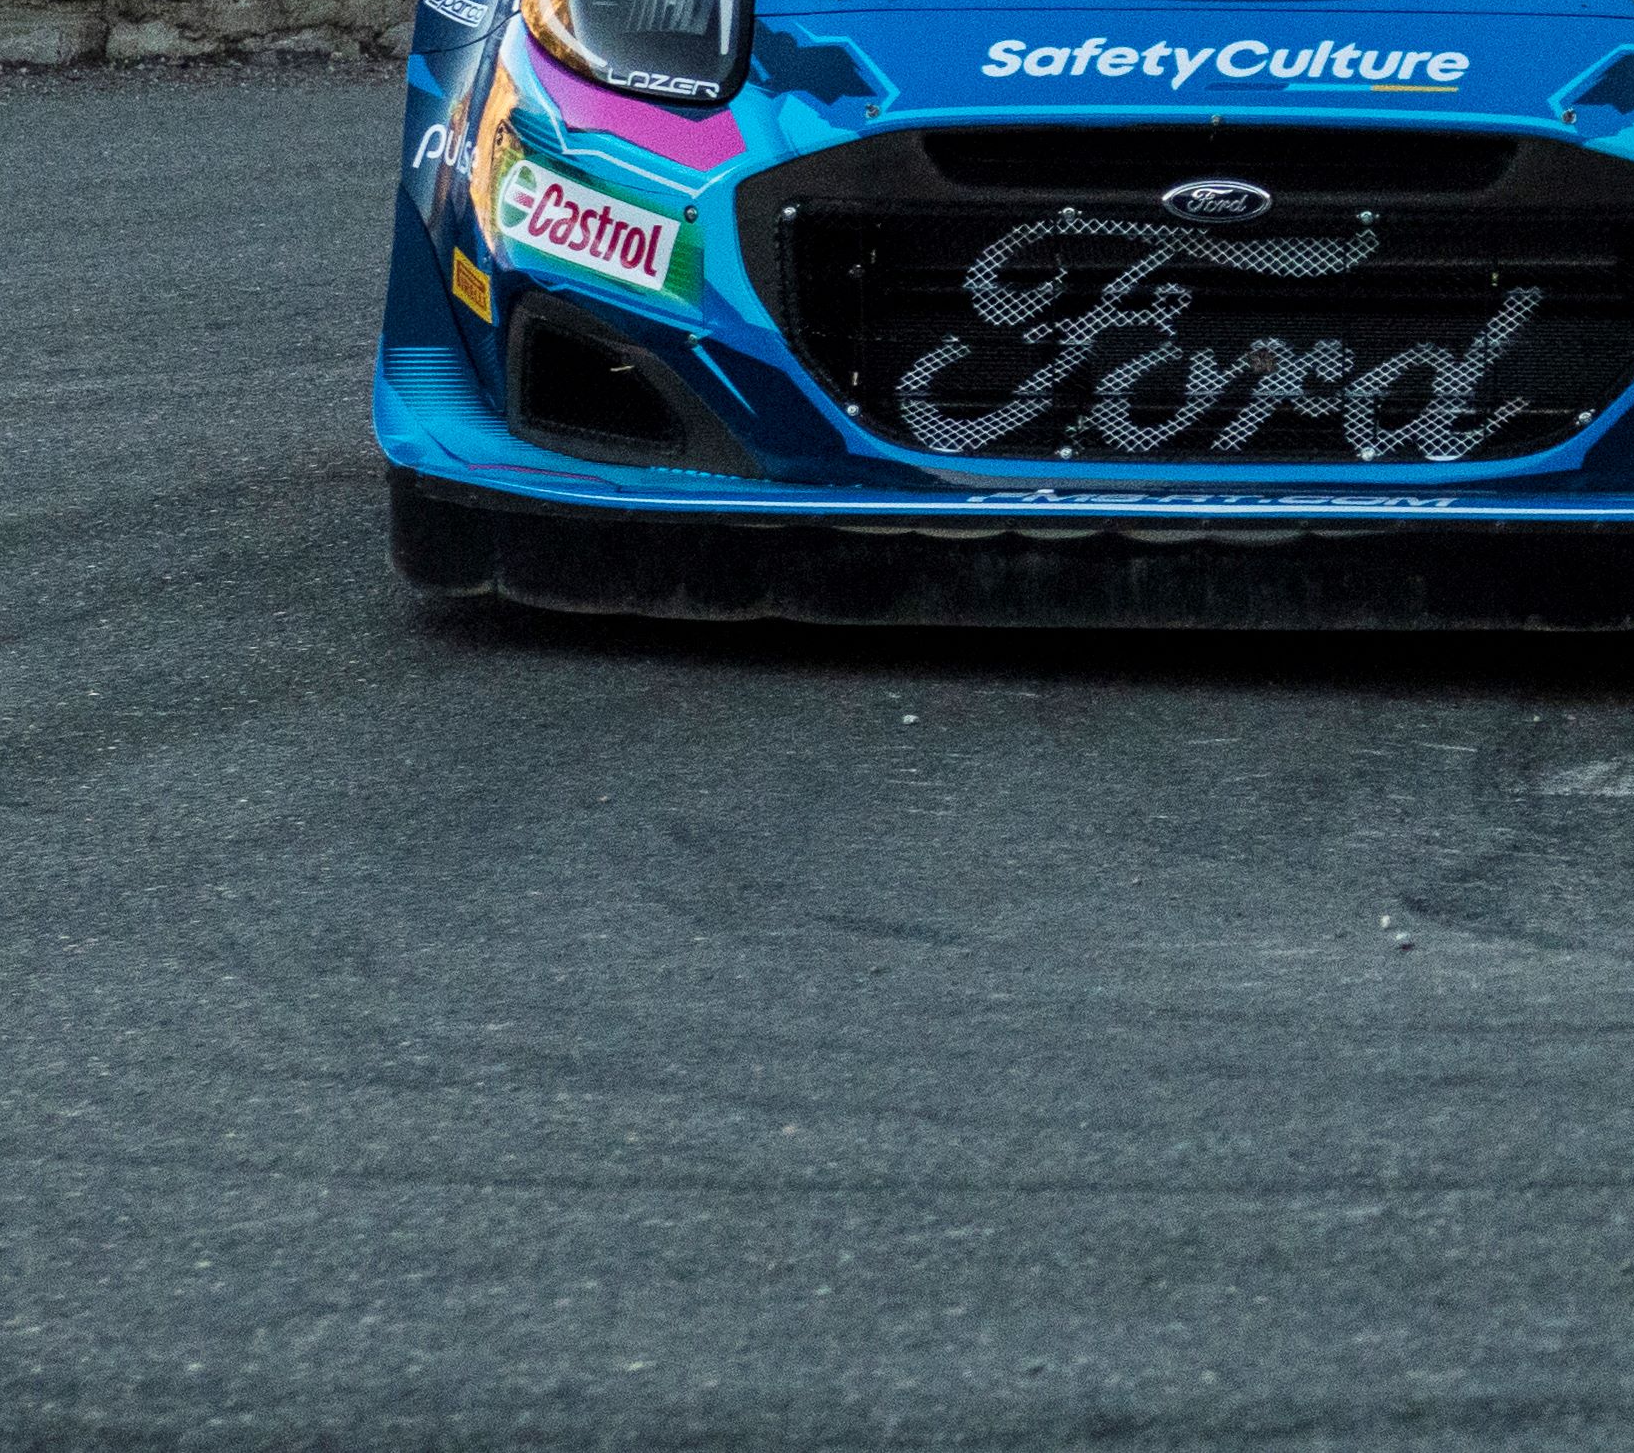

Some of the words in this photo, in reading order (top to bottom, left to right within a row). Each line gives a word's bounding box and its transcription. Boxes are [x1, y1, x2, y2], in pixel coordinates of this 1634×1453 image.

[981, 37, 1470, 90] SafetyCulture
[527, 183, 661, 278] Castrol
[1187, 188, 1248, 212] Ford
[896, 217, 1542, 461] Ford
